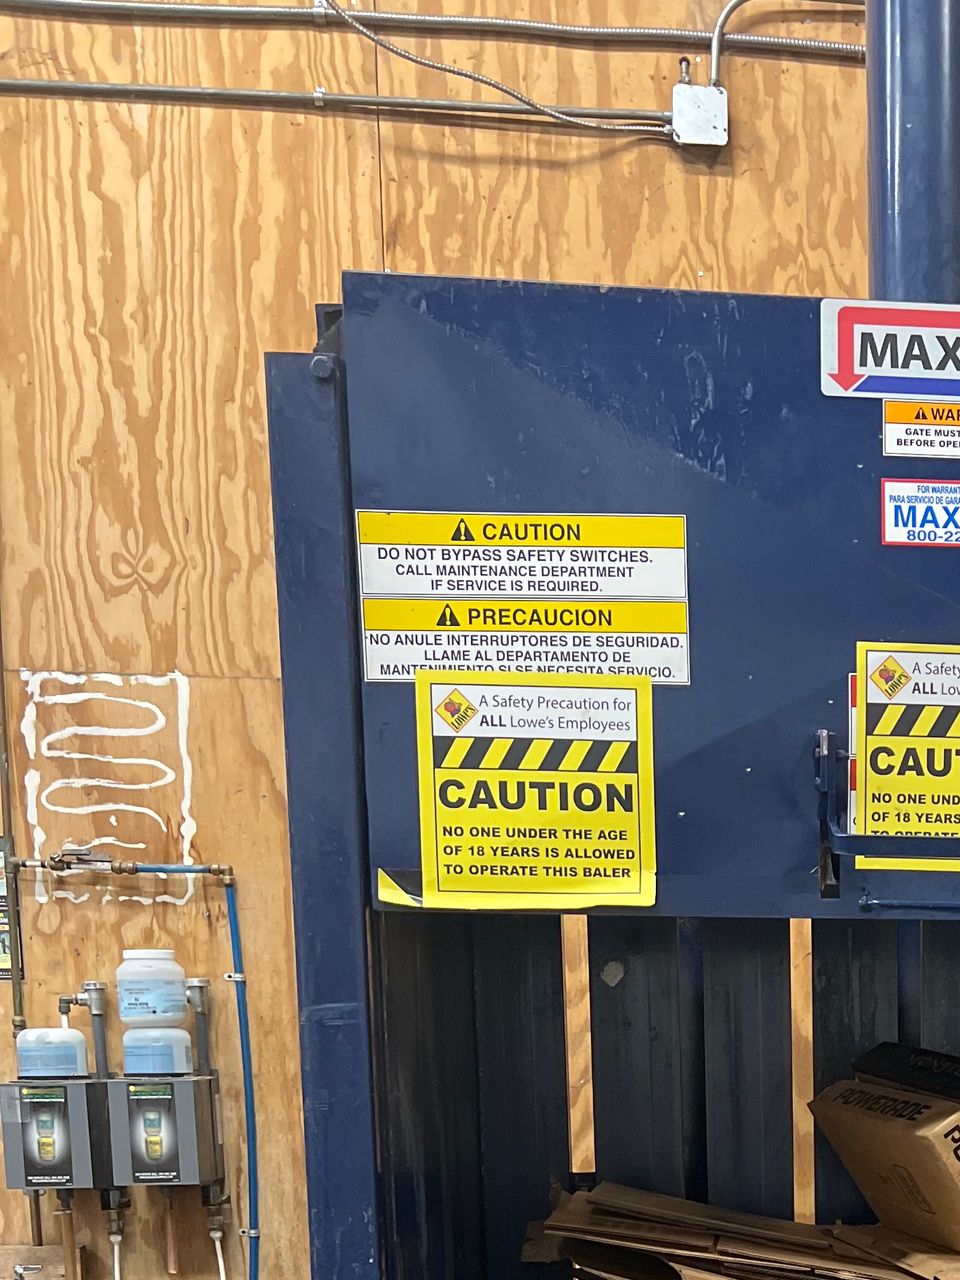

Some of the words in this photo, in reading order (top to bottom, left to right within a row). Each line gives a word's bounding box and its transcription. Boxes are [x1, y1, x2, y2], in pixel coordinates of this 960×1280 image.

[905, 428, 931, 436] GATE
[896, 438, 935, 448] BEFORE
[917, 485, 930, 494] FOR
[483, 523, 581, 541] CAUTION
[378, 547, 401, 560] DO
[405, 548, 436, 561] NOT
[441, 548, 501, 562] BYPASS
[507, 549, 564, 562] SAFETY
[570, 550, 653, 563] SWITCHES.
[396, 564, 432, 576] CALL
[436, 564, 537, 577] MAINTENANCE
[541, 565, 634, 578] DEPARTMENT
[431, 579, 443, 590] IF
[447, 579, 507, 591] SERVICE
[511, 580, 524, 591] IS
[528, 580, 602, 592] REQUIRED.
[467, 608, 612, 626] PRECAUCION
[370, 634, 391, 646] NO
[395, 634, 443, 647] ANULE
[447, 634, 568, 648] INTERRUPTORES
[573, 636, 592, 648] DE
[596, 636, 683, 649] SEGURIDAD.
[424, 649, 471, 662] LLAME
[474, 650, 492, 662] AL
[496, 650, 609, 663] DEPARTAMENTO
[612, 651, 631, 663] DE
[912, 662, 921, 674] A
[912, 683, 937, 695] ALL
[479, 695, 490, 707] A
[492, 695, 534, 709] Safety
[538, 696, 609, 710] Precaution
[613, 698, 632, 711] for
[479, 715, 506, 727] ALL
[510, 716, 554, 729] Lowe's
[558, 717, 631, 732] Employees
[438, 779, 634, 813] CAUTION
[871, 793, 892, 803] NO
[897, 794, 926, 805] ONE
[871, 812, 889, 822] OF
[895, 812, 910, 823] 18
[442, 826, 464, 837] NO
[469, 827, 500, 837] ONE
[506, 828, 558, 839] UNDER
[562, 829, 592, 839] THE
[597, 830, 628, 840] AGE
[443, 846, 462, 856] OF
[468, 846, 484, 856] 18
[490, 847, 540, 857] YEARS
[545, 848, 559, 858] IS
[564, 849, 635, 860] ALLOWED
[444, 864, 464, 874] TO
[469, 865, 538, 876] OPERATE
[543, 867, 577, 877] THIS
[583, 867, 631, 878] BALER
[831, 1088, 933, 1121] POWERADE
